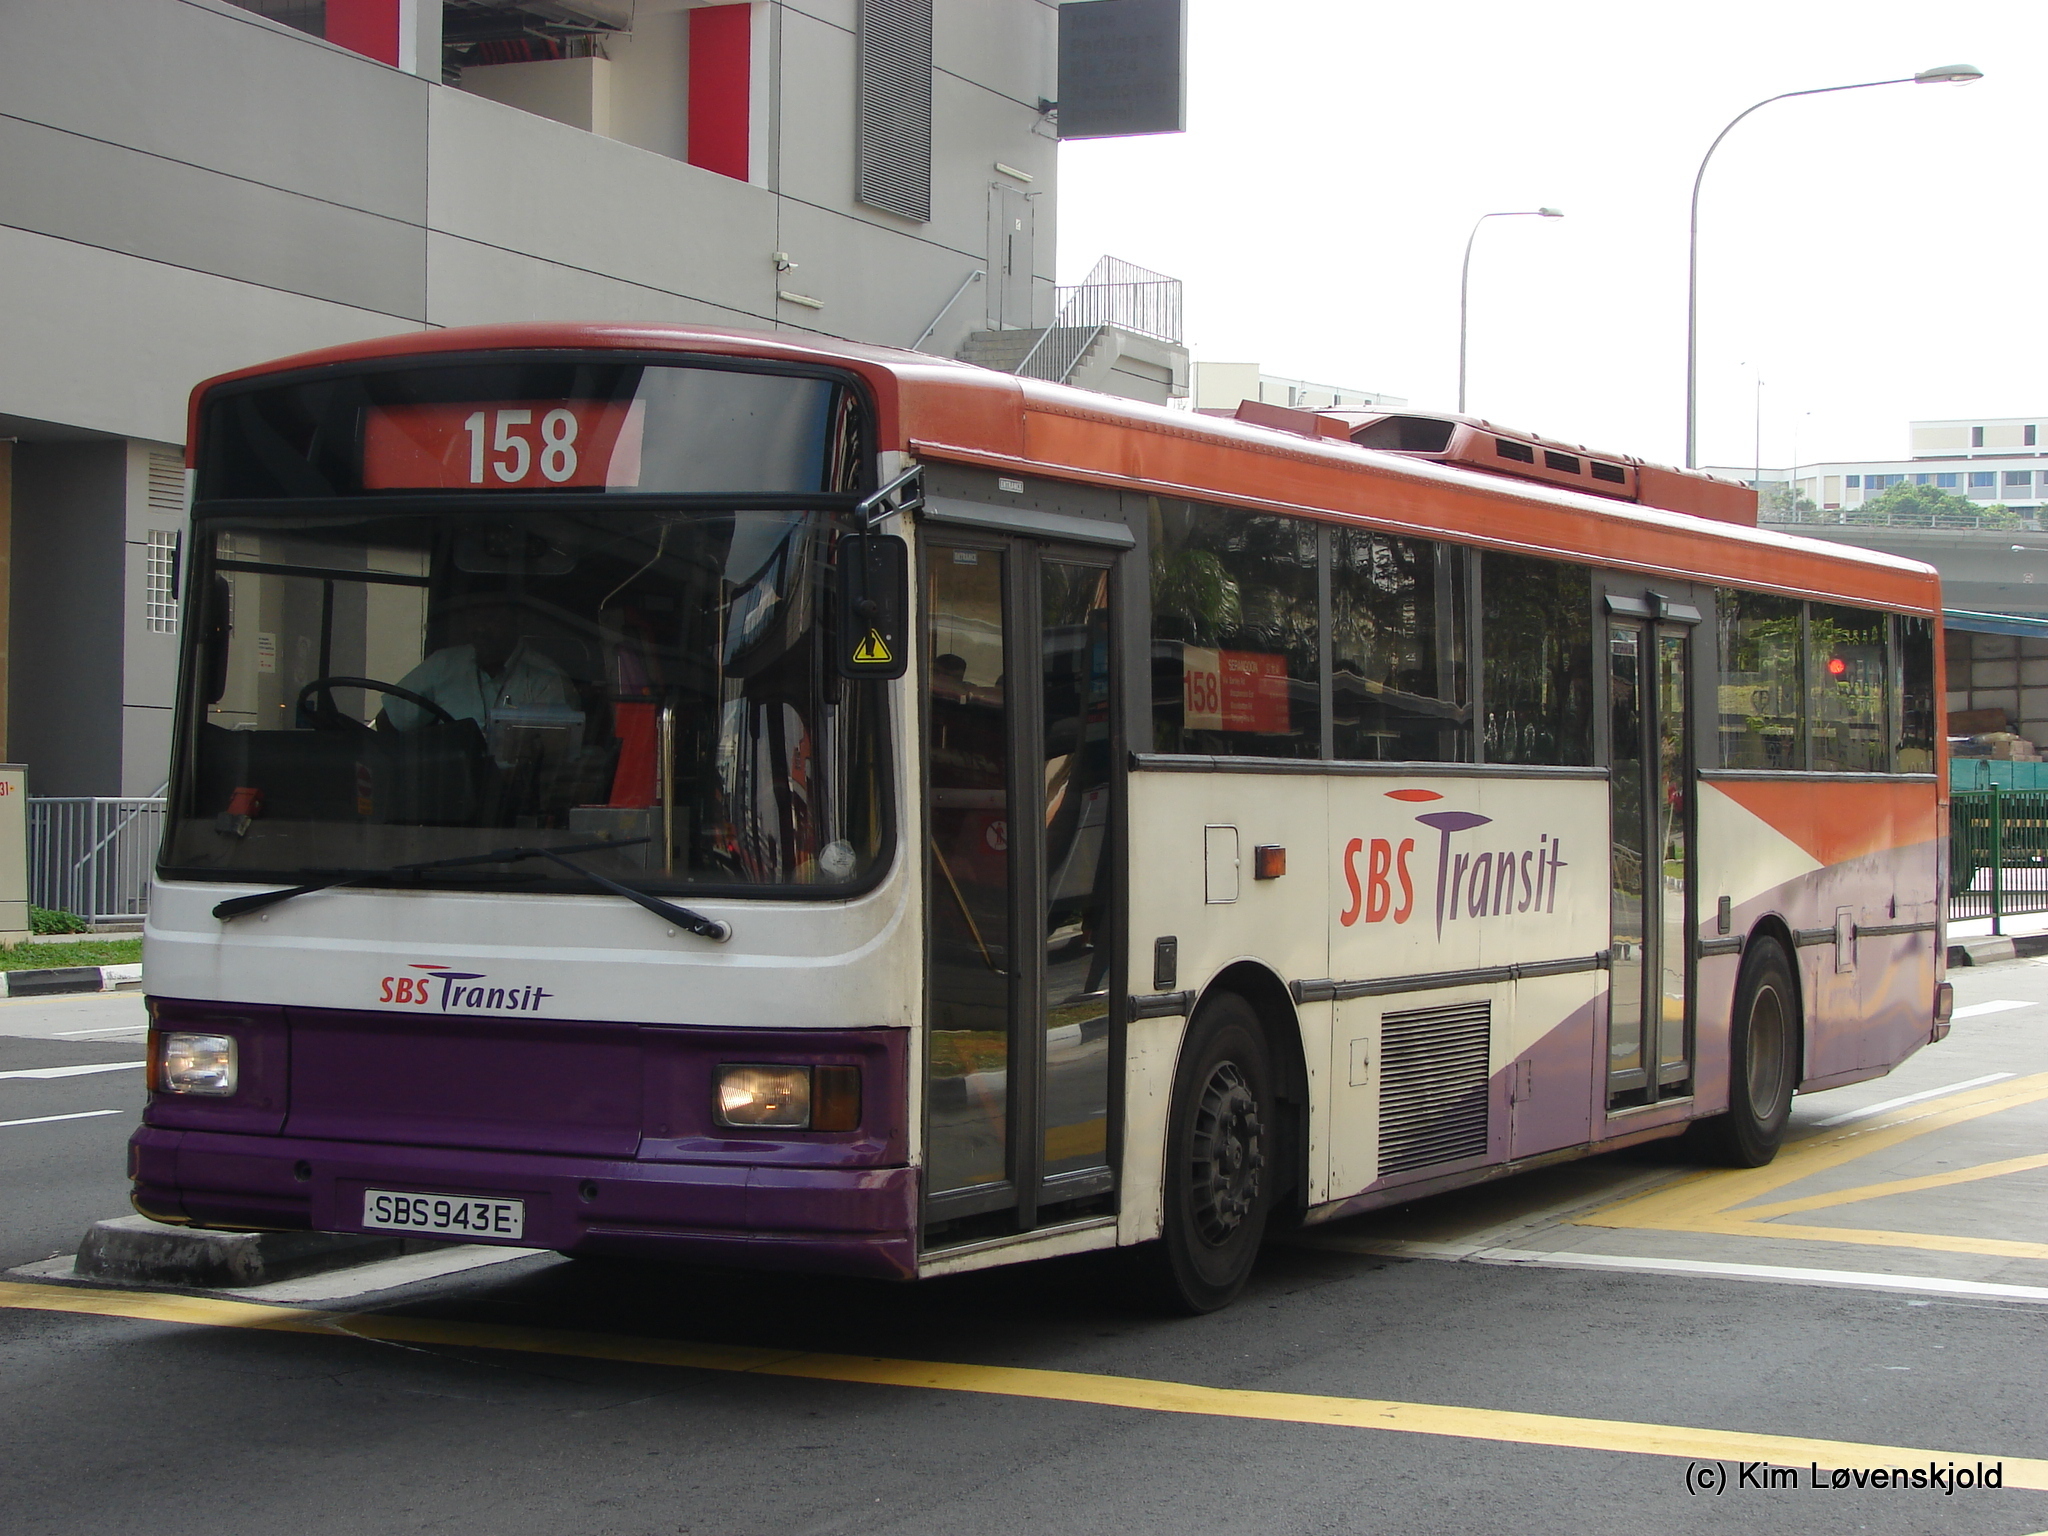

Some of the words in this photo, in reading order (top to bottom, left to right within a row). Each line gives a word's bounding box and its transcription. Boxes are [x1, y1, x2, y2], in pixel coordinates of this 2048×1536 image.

[464, 408, 578, 483] 158
[1184, 670, 1219, 714] 158
[1340, 837, 1415, 927] SBS
[1414, 811, 1568, 945] Transit
[379, 976, 430, 1005] SBS
[426, 972, 555, 1012] Transit
[375, 1195, 512, 1233] SBS943E
